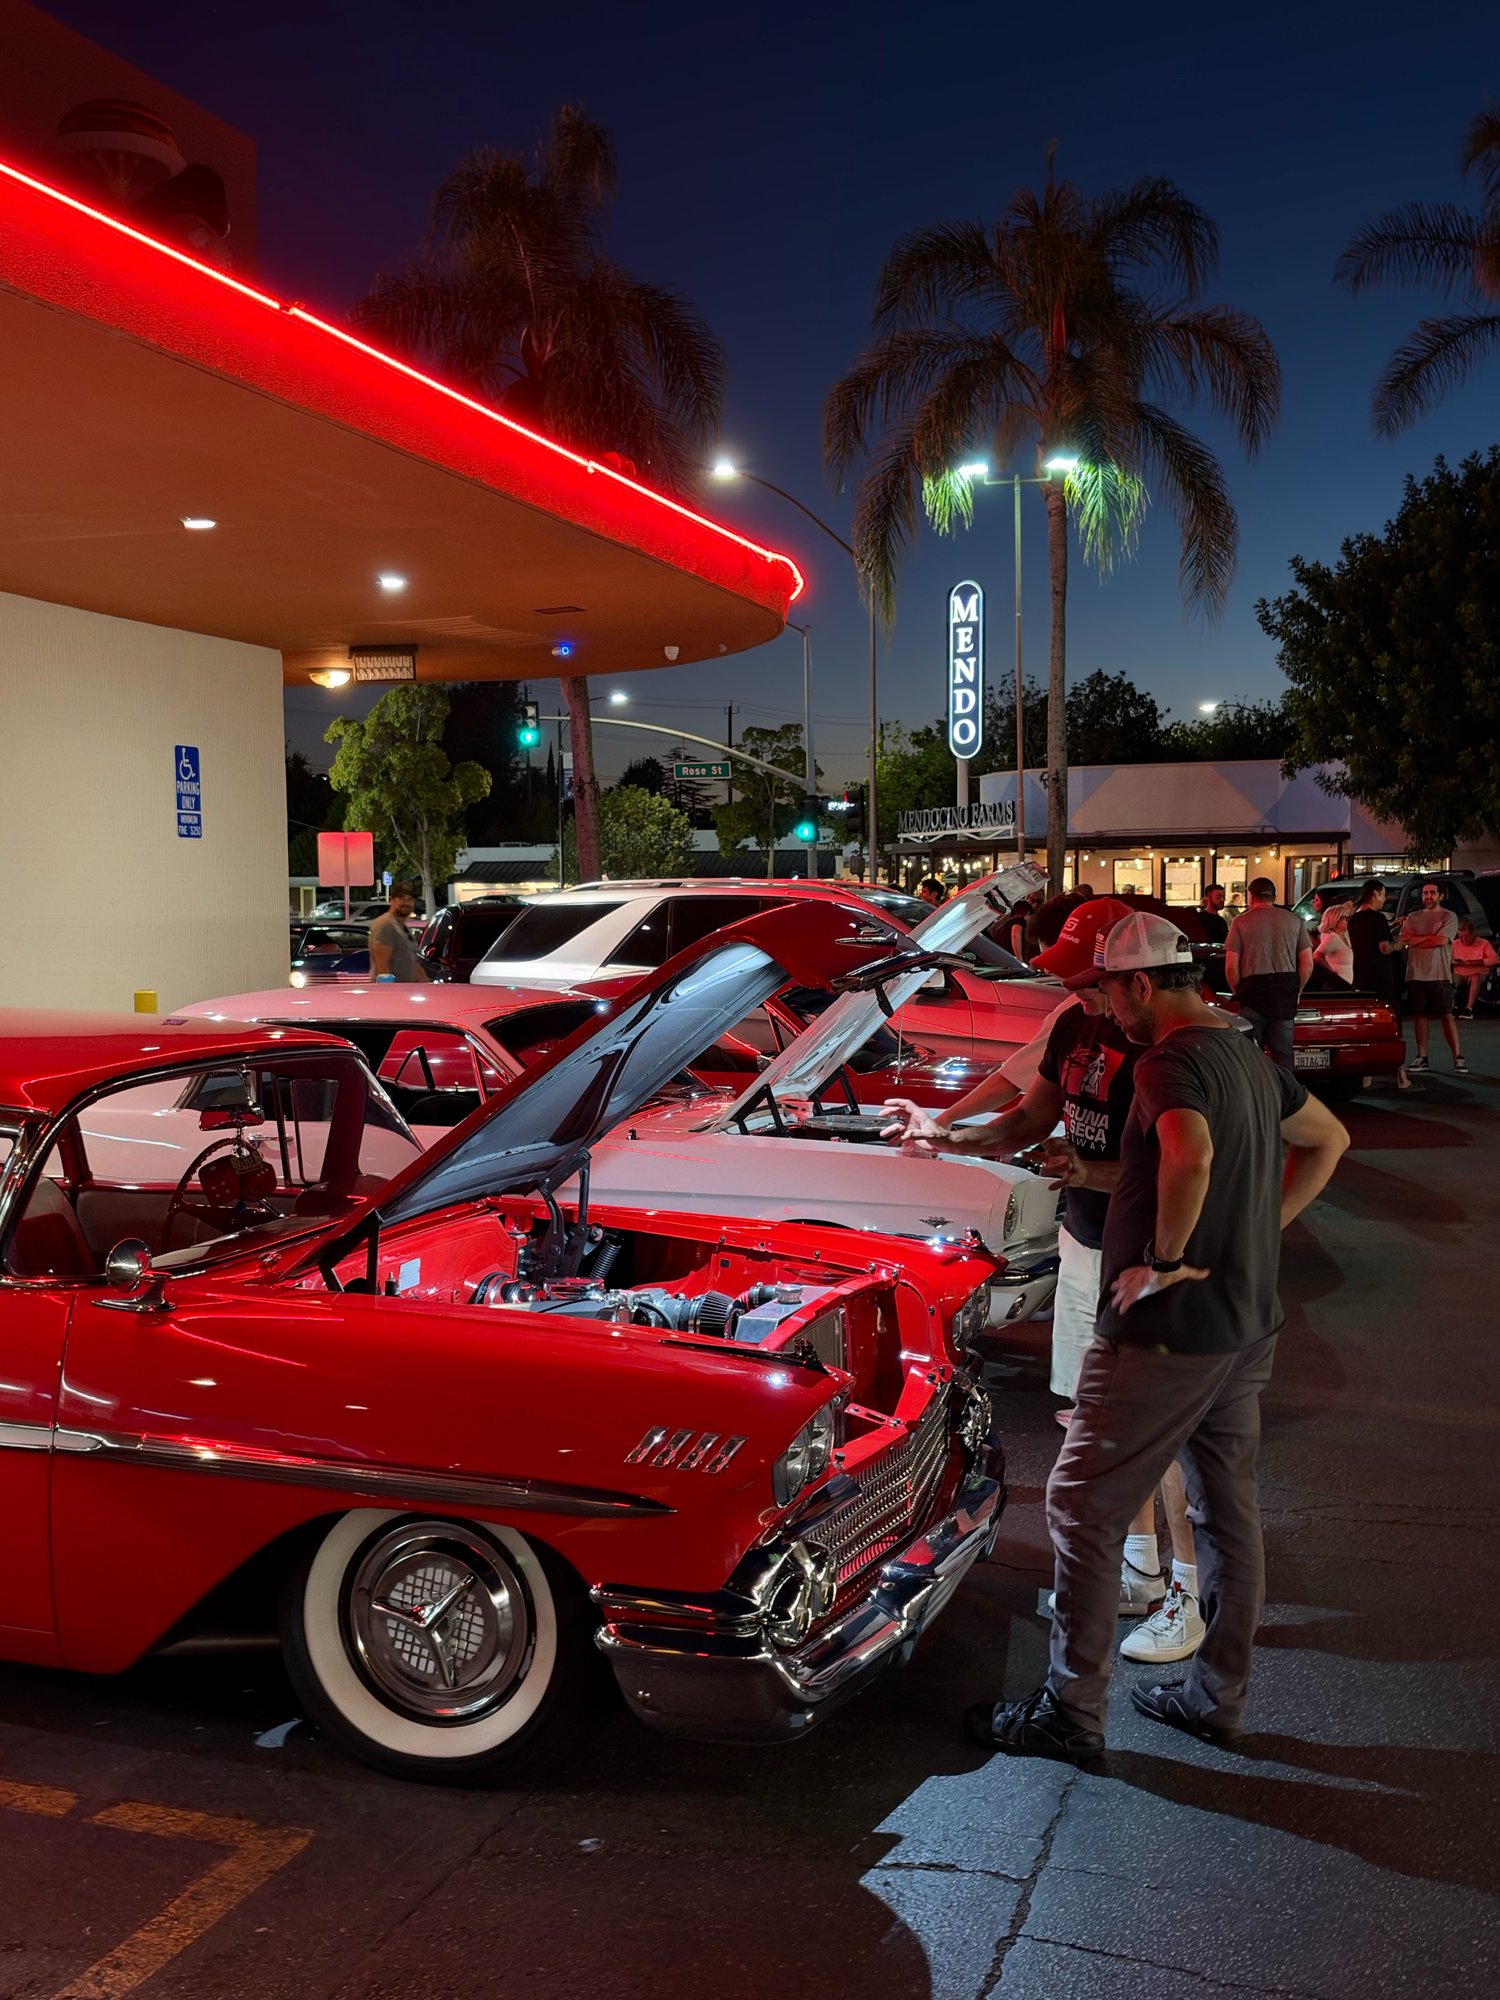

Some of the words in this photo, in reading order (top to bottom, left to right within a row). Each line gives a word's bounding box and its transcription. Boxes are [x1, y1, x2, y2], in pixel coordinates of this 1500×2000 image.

[952, 594, 978, 744] MENDO
[682, 766, 706, 776] Rose
[711, 765, 722, 775] St
[177, 781, 200, 796] PARKING
[181, 796, 196, 810] ONLY
[180, 814, 199, 825] MINIMUM
[897, 805, 969, 833] MENDOCINO
[971, 799, 1015, 827] FARMS
[178, 825, 188, 836] FINE
[190, 826, 201, 837] $250
[1063, 1100, 1109, 1130] AGUNA
[1069, 1118, 1107, 1144] SECA
